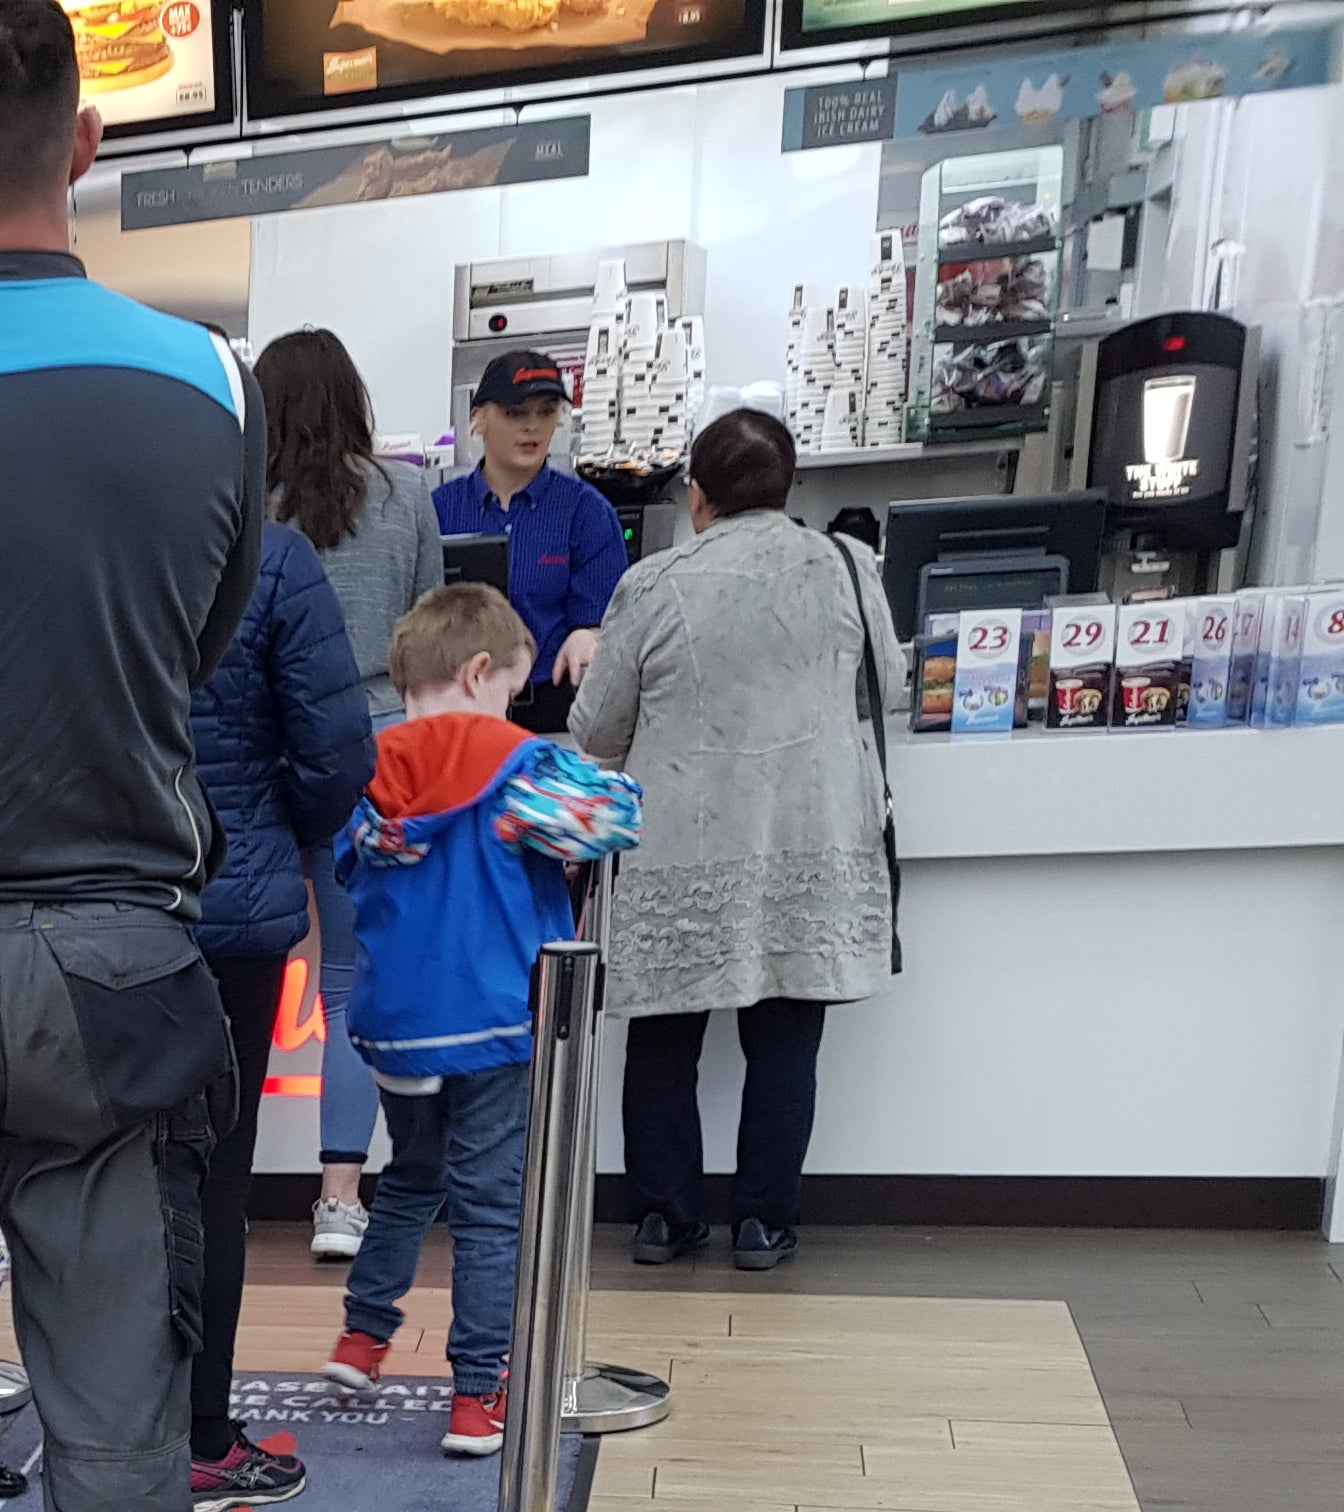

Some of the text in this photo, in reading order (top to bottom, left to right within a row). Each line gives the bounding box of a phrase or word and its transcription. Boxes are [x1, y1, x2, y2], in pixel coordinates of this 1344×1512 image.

[849, 103, 885, 120] DAIRY
[817, 118, 879, 138] ICE CREAM
[136, 188, 176, 208] FRESH
[241, 172, 304, 195] TENDERS
[969, 625, 1008, 651] 23
[1062, 621, 1102, 647] 29
[1130, 619, 1169, 645] 21
[1202, 616, 1227, 641] 26
[321, 1410, 390, 1425] YOU
